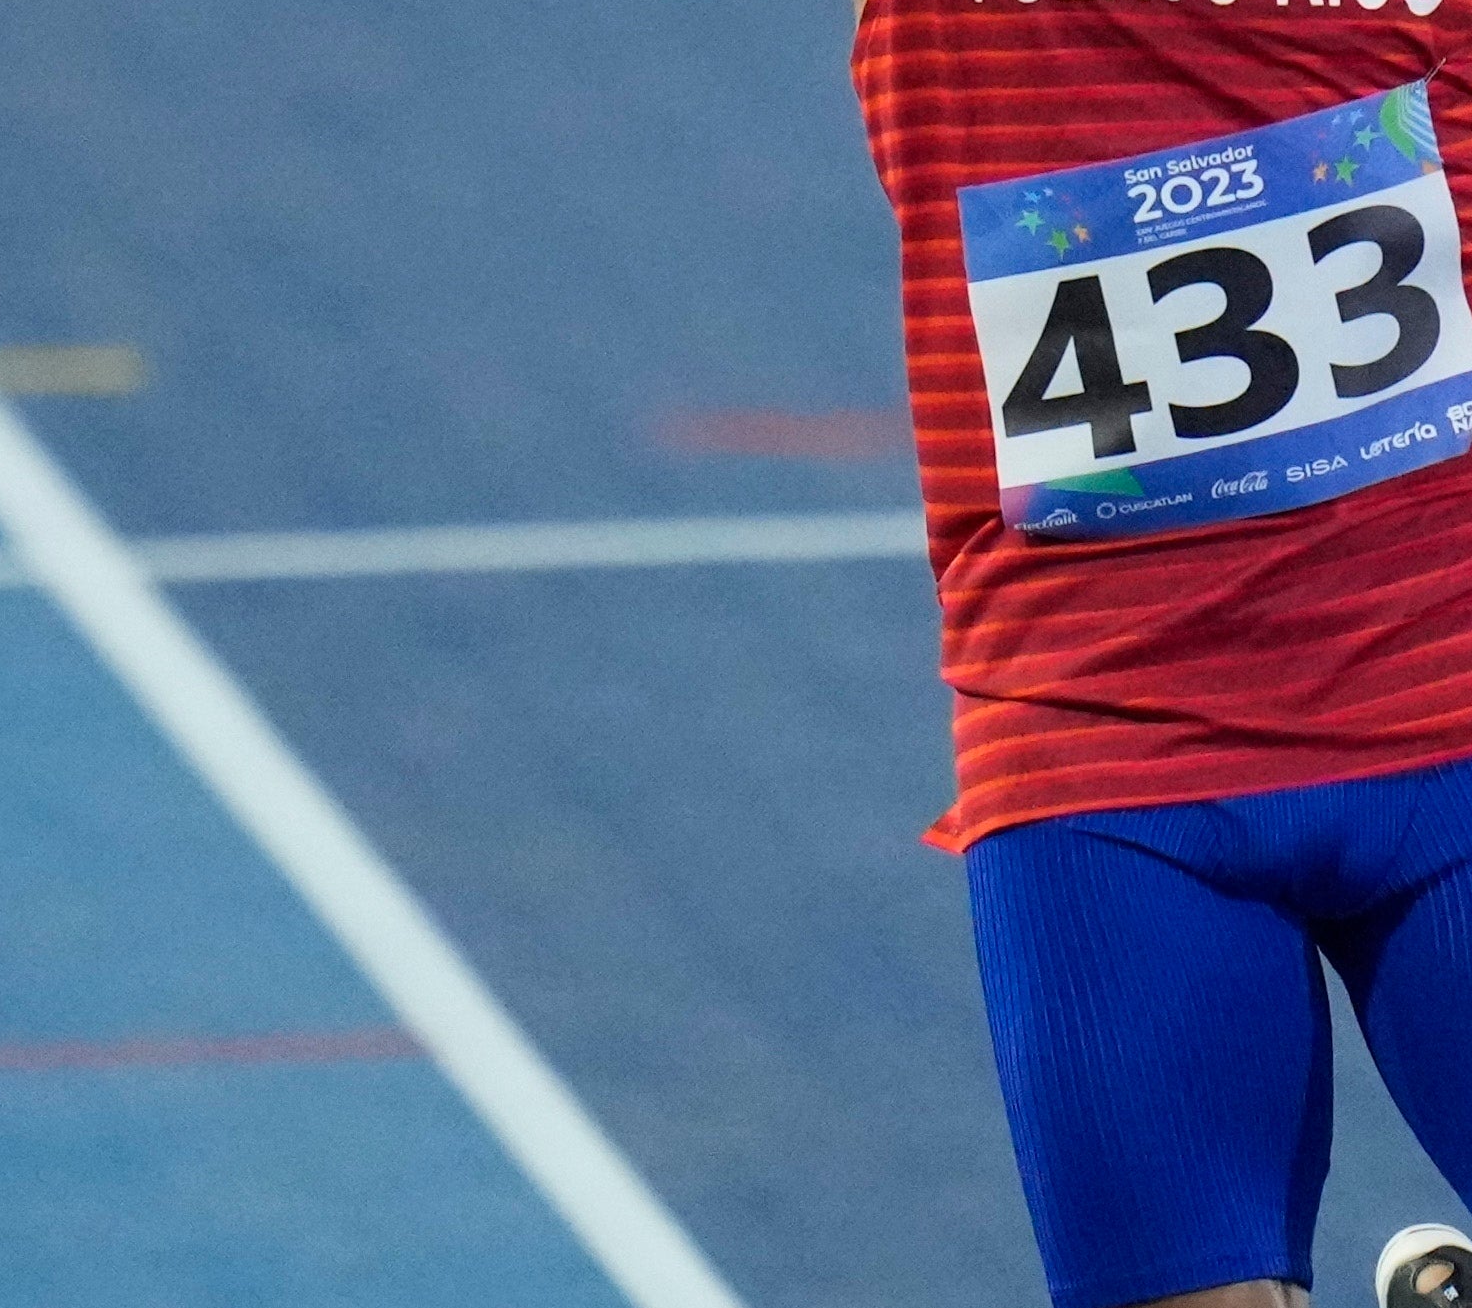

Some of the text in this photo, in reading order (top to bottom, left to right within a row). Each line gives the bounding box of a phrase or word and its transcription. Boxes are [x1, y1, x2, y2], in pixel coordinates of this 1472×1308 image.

[1124, 144, 1254, 184] San Salvador
[1127, 159, 1265, 224] 2023
[1001, 204, 1441, 460] 433
[1286, 455, 1348, 482] SISA
